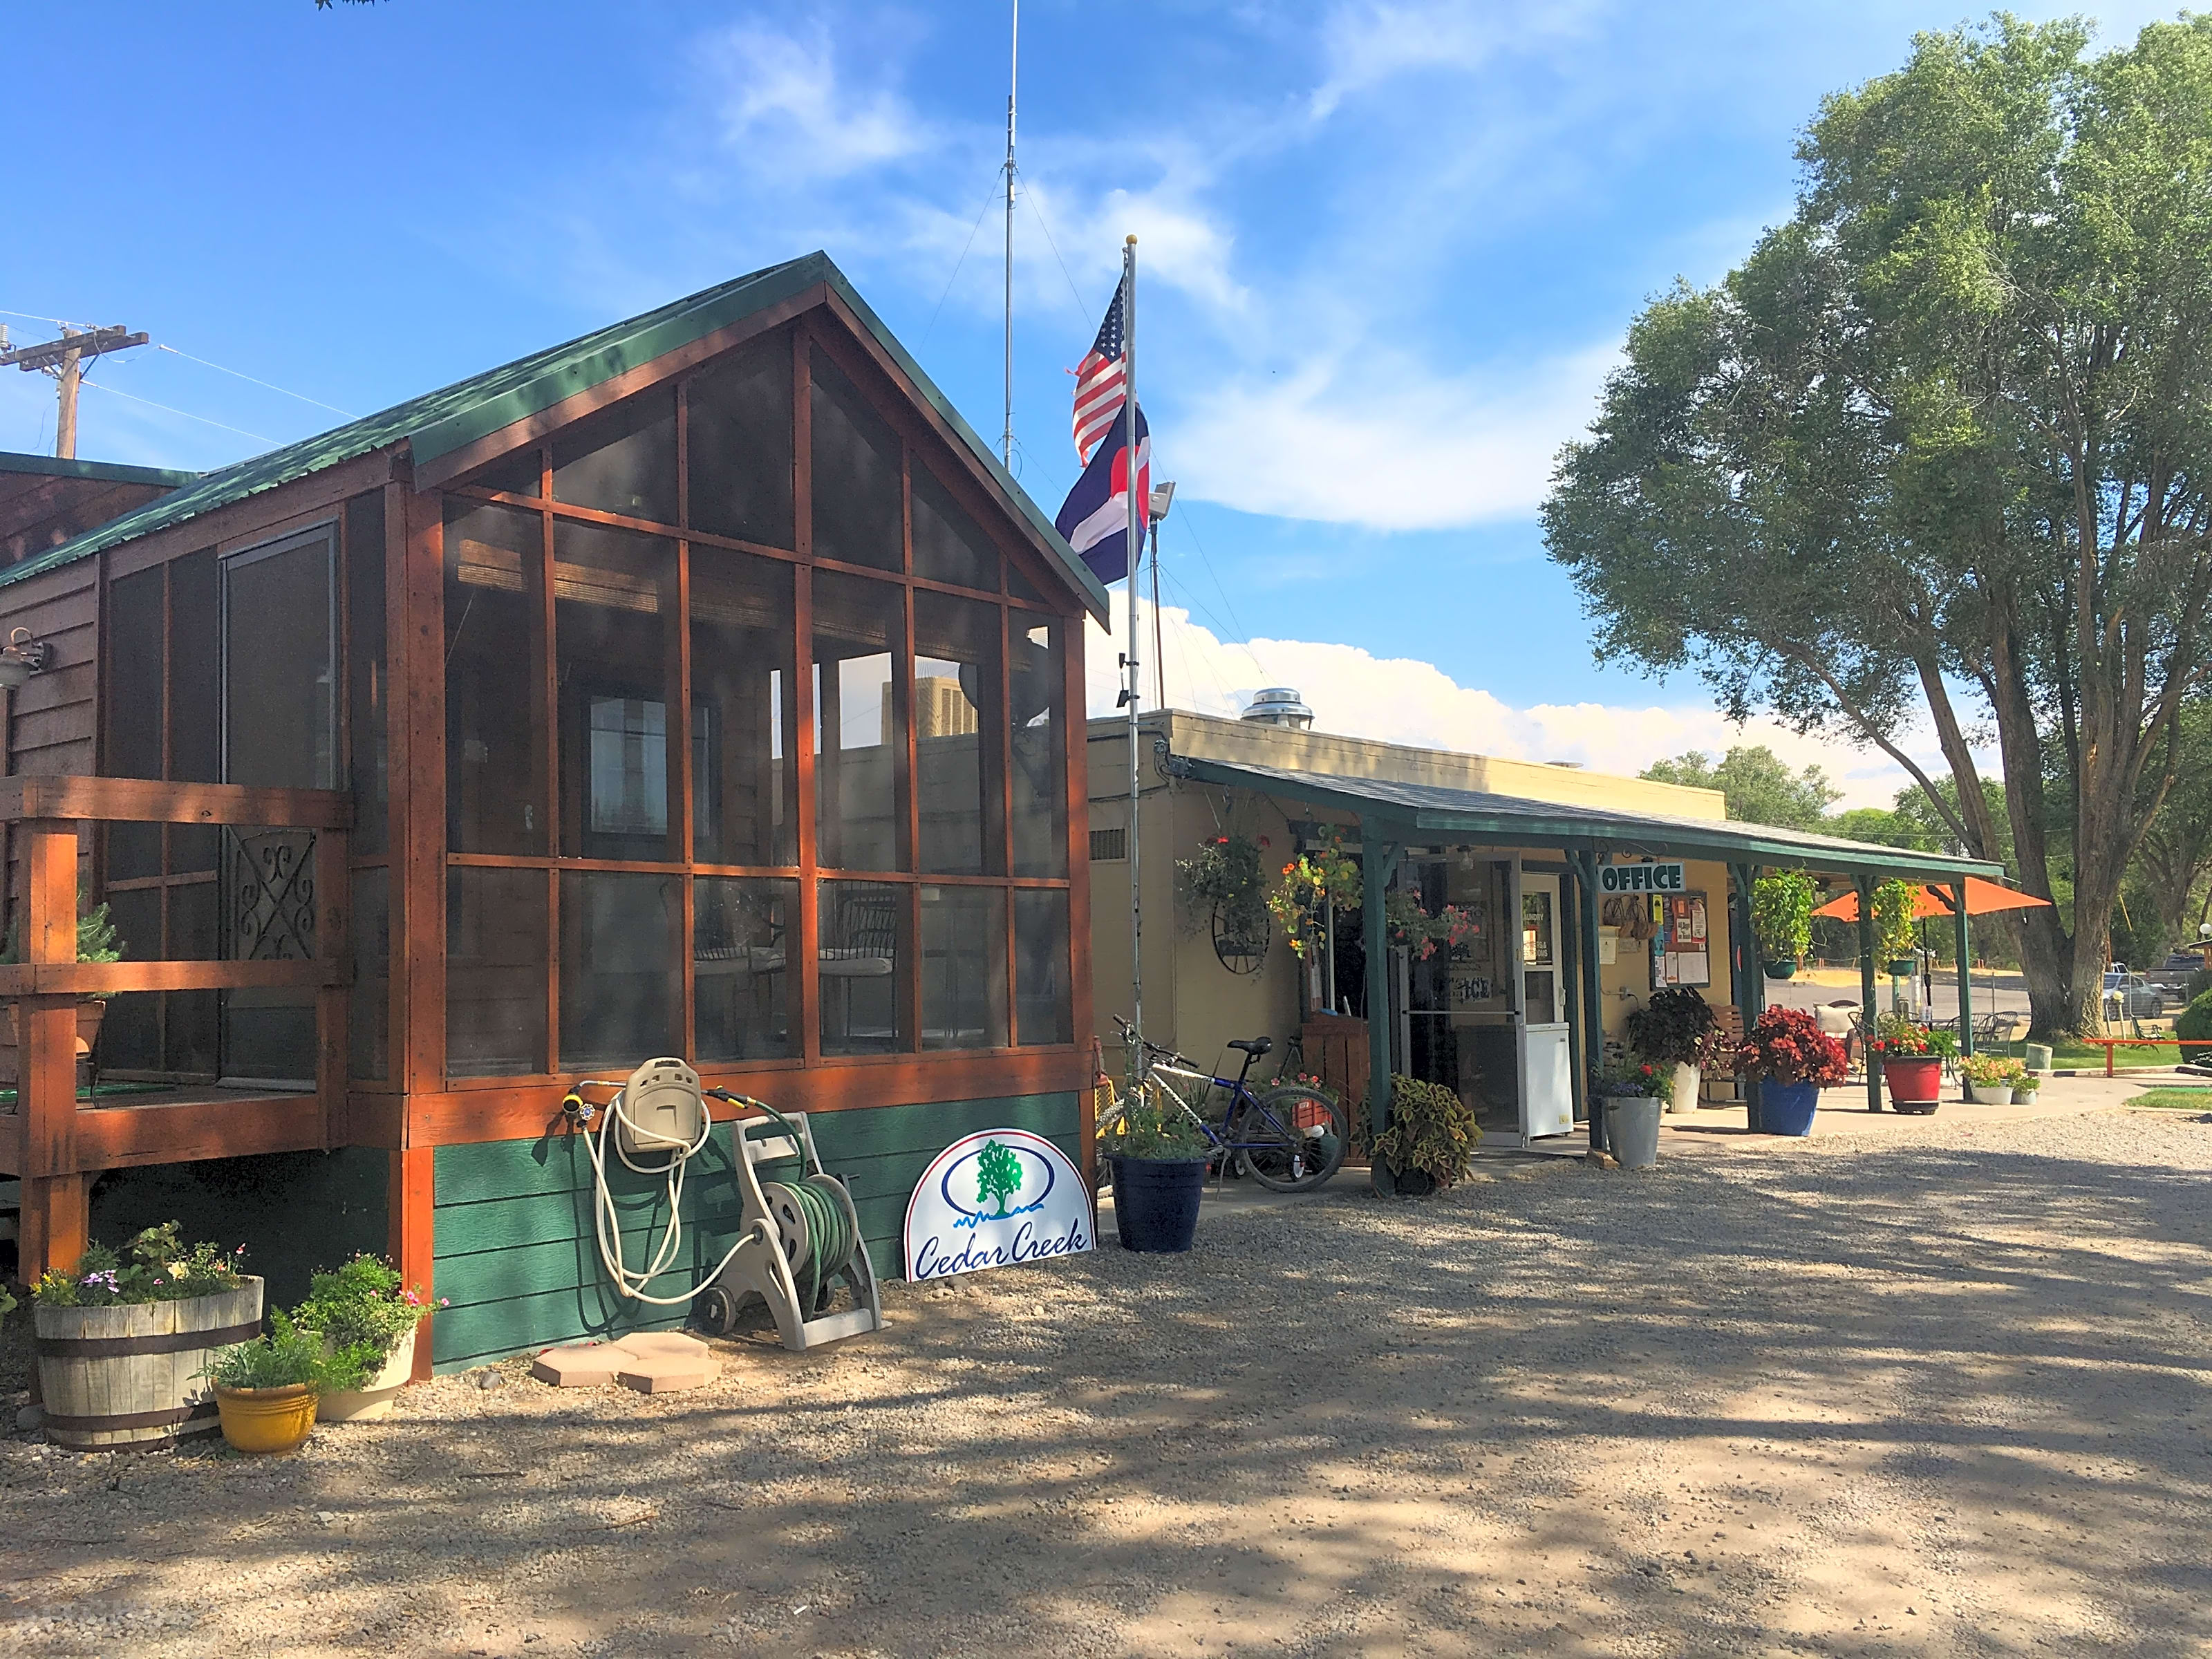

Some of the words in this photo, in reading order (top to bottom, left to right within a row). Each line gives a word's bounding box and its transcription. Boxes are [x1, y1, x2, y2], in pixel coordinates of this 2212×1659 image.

[1602, 865, 1680, 890] OFFICE
[915, 1232, 1009, 1280] Cedar
[1011, 1218, 1087, 1262] Creek
